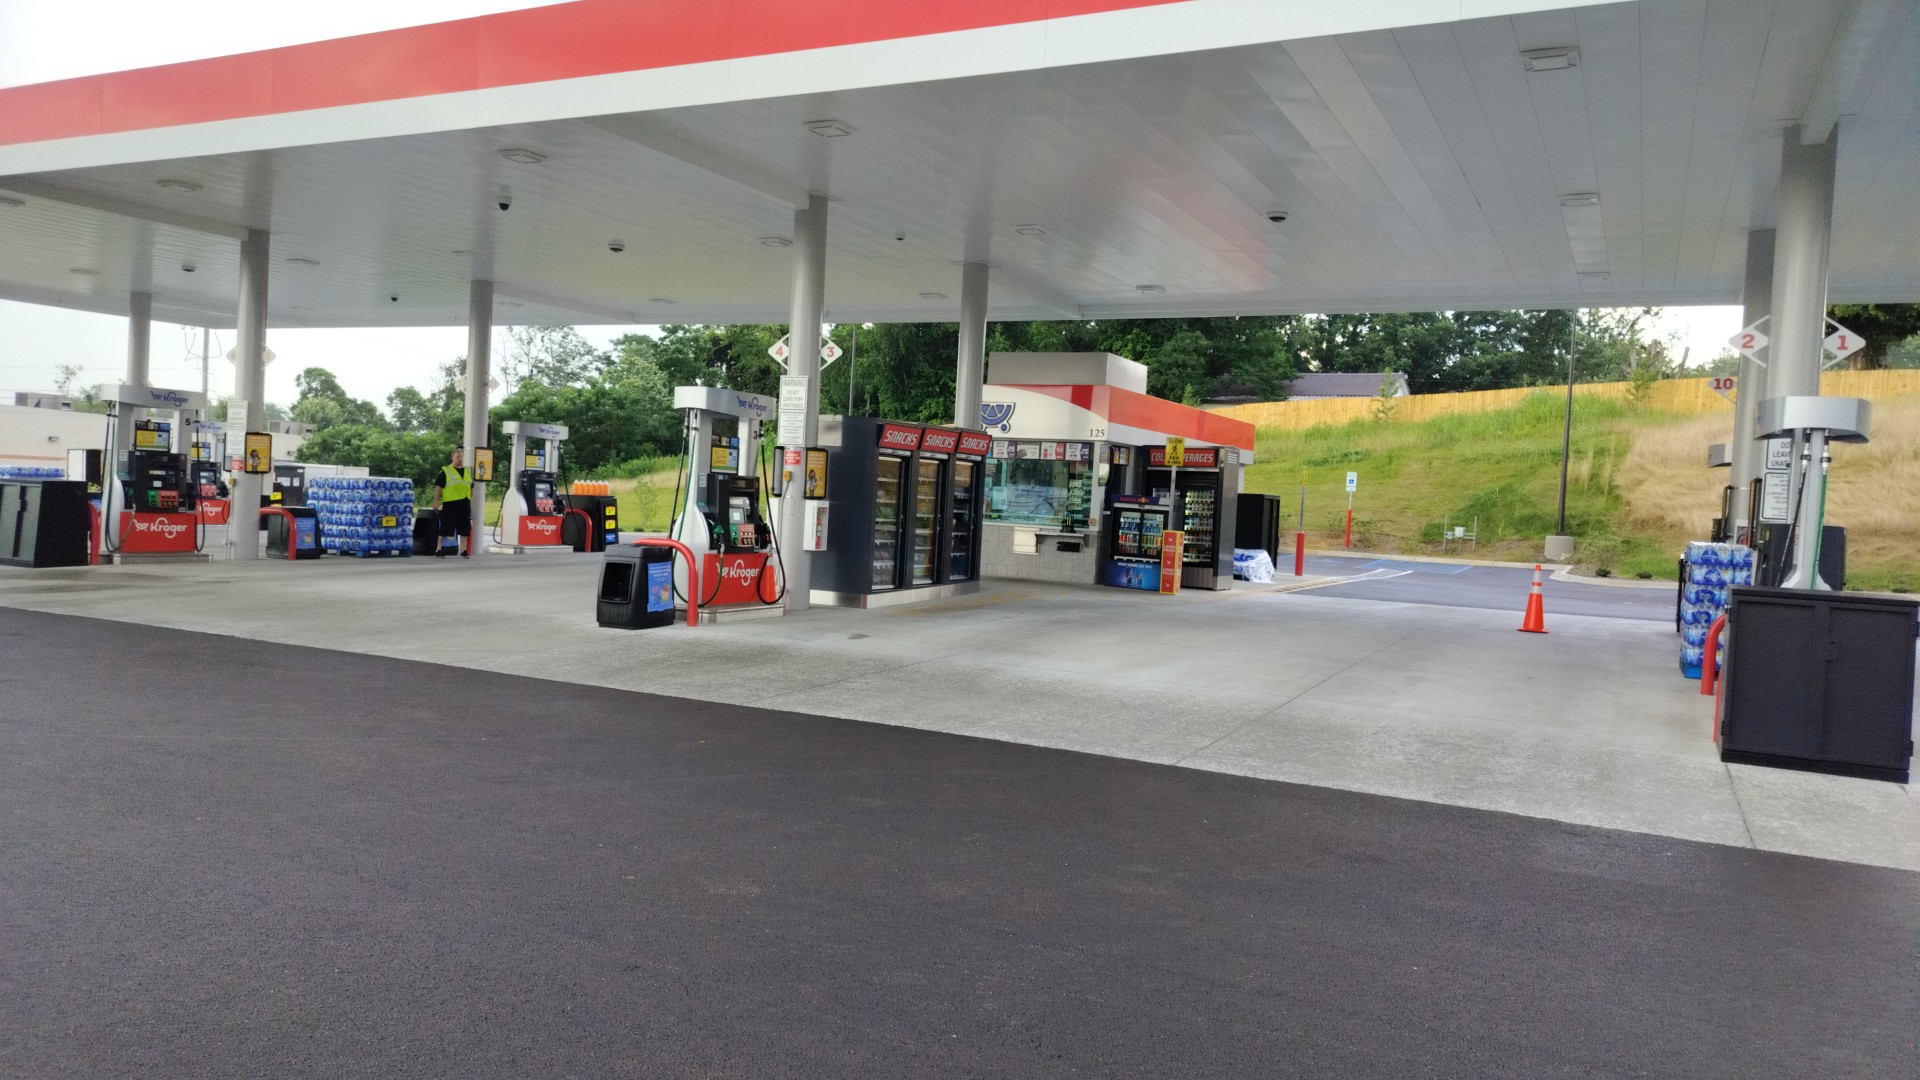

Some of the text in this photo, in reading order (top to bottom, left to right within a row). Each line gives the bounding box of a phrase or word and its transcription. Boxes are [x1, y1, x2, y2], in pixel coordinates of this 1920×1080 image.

[1741, 333, 1755, 349] 2
[1837, 335, 1848, 350] 1
[775, 346, 783, 357] 4
[827, 346, 835, 357] 3
[782, 378, 806, 387] WARNING
[1713, 378, 1734, 390] 10
[163, 391, 189, 408] Kroger
[747, 397, 767, 417] Kroger
[184, 418, 191, 426] 5
[546, 426, 560, 438] Kroger
[753, 430, 758, 440] 3
[884, 430, 918, 446] SNACKS
[1089, 428, 1105, 438] 125
[924, 434, 956, 449] SNACKS
[960, 436, 988, 451] SNACKS
[1780, 441, 1790, 449] DO
[1183, 453, 1213, 463] VERAGES
[199, 502, 222, 517] Kroger
[150, 517, 188, 539] Kroger
[536, 519, 557, 535] Kroger
[729, 559, 760, 586] Kroger
